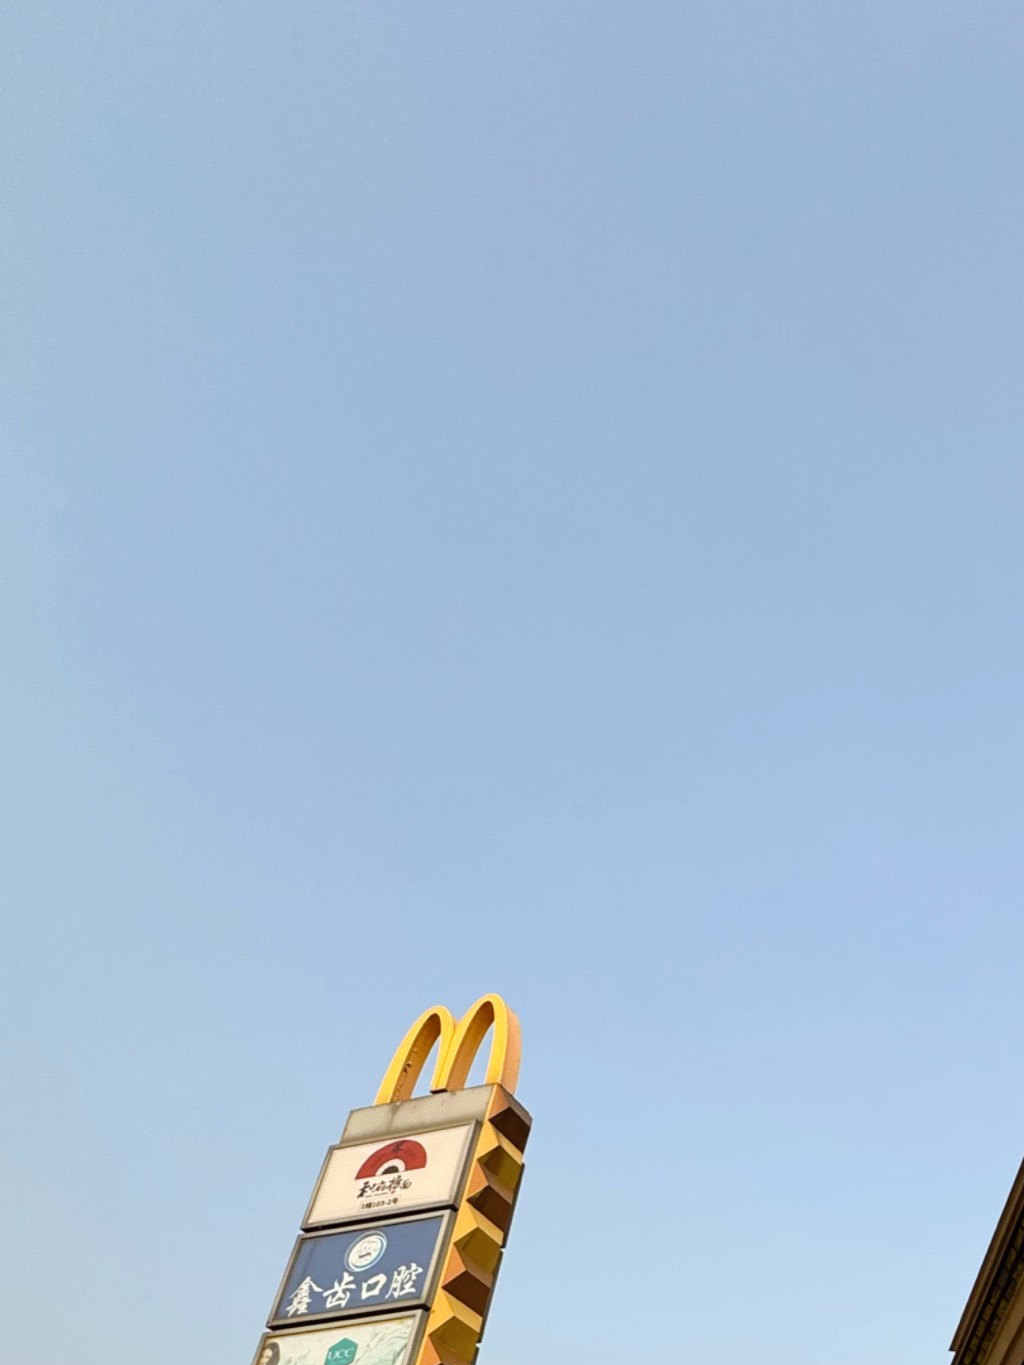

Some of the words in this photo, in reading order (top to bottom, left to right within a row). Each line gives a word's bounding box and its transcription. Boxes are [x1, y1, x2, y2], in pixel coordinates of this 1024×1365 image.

[286, 1262, 423, 1317] 鑫齿口腔
[328, 1348, 354, 1361] UCC
